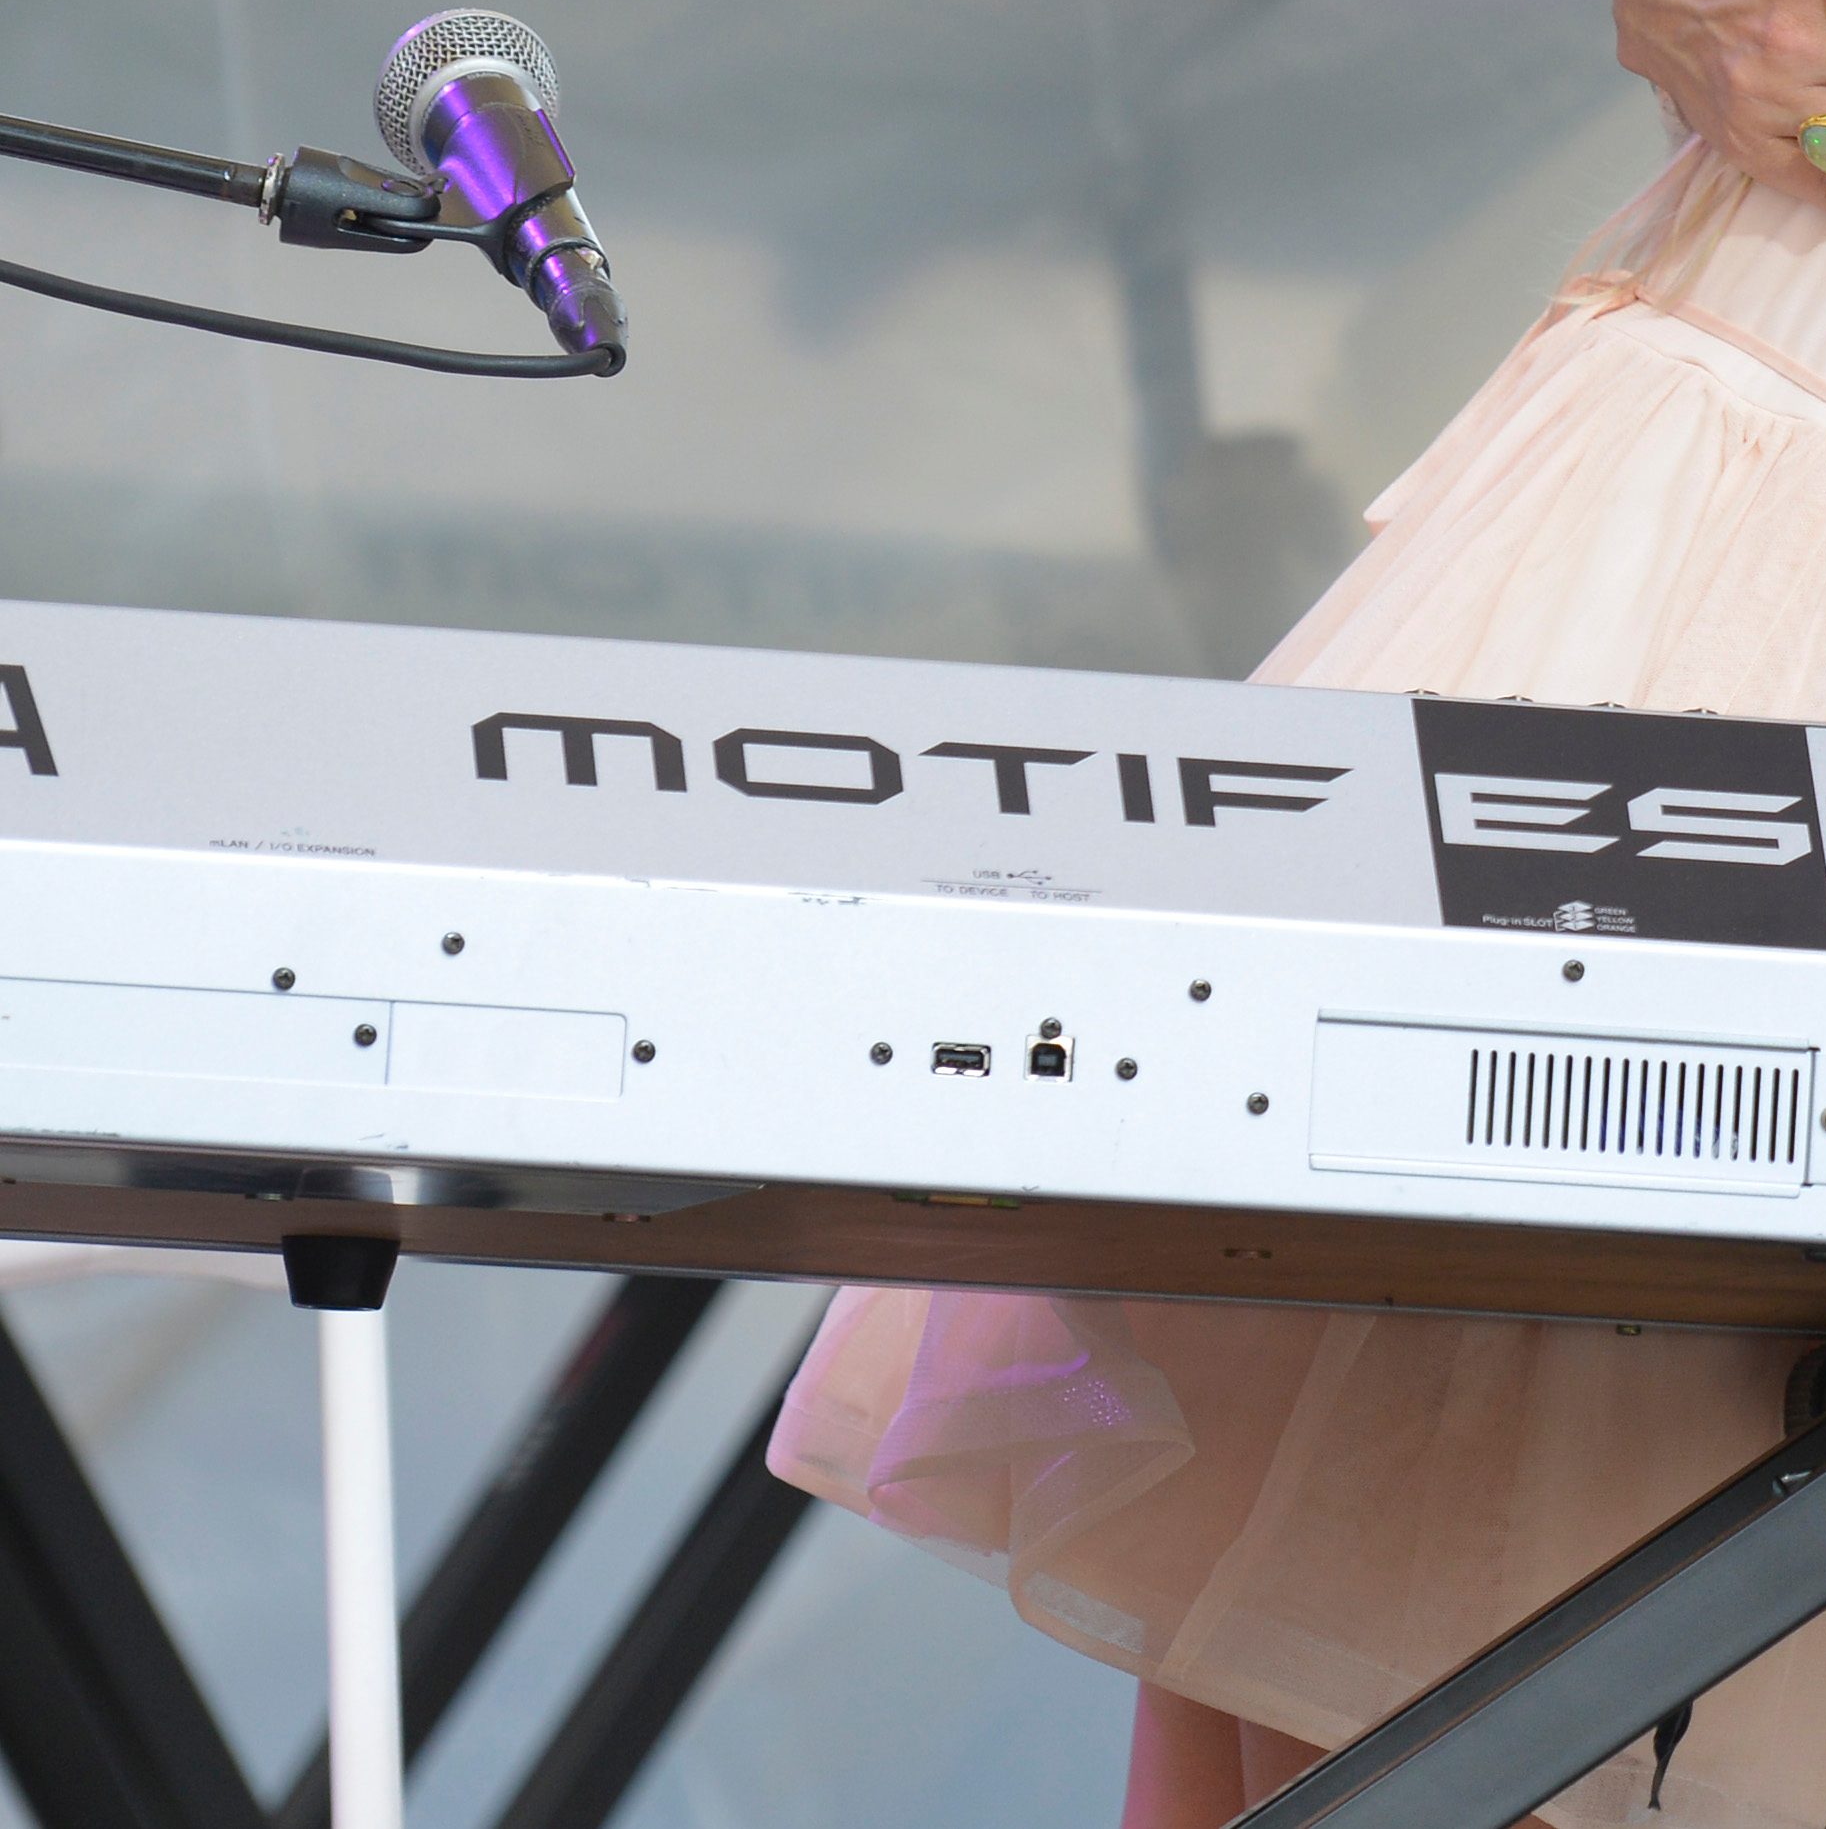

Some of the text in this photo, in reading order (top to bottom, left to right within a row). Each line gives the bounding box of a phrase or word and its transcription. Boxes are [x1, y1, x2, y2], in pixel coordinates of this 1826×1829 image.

[471, 712, 1354, 827] MOTIF
[209, 839, 248, 849] mLAN
[297, 843, 376, 857] EXPANSION
[972, 870, 1001, 879] USB
[936, 884, 1009, 897] TO DEVICE
[1031, 890, 1090, 902] TO HOST
[1594, 907, 1626, 916] GREEN
[1523, 916, 1553, 927] SLOT
[1596, 916, 1635, 924] YELLOW
[1596, 924, 1636, 933] ORANGE
